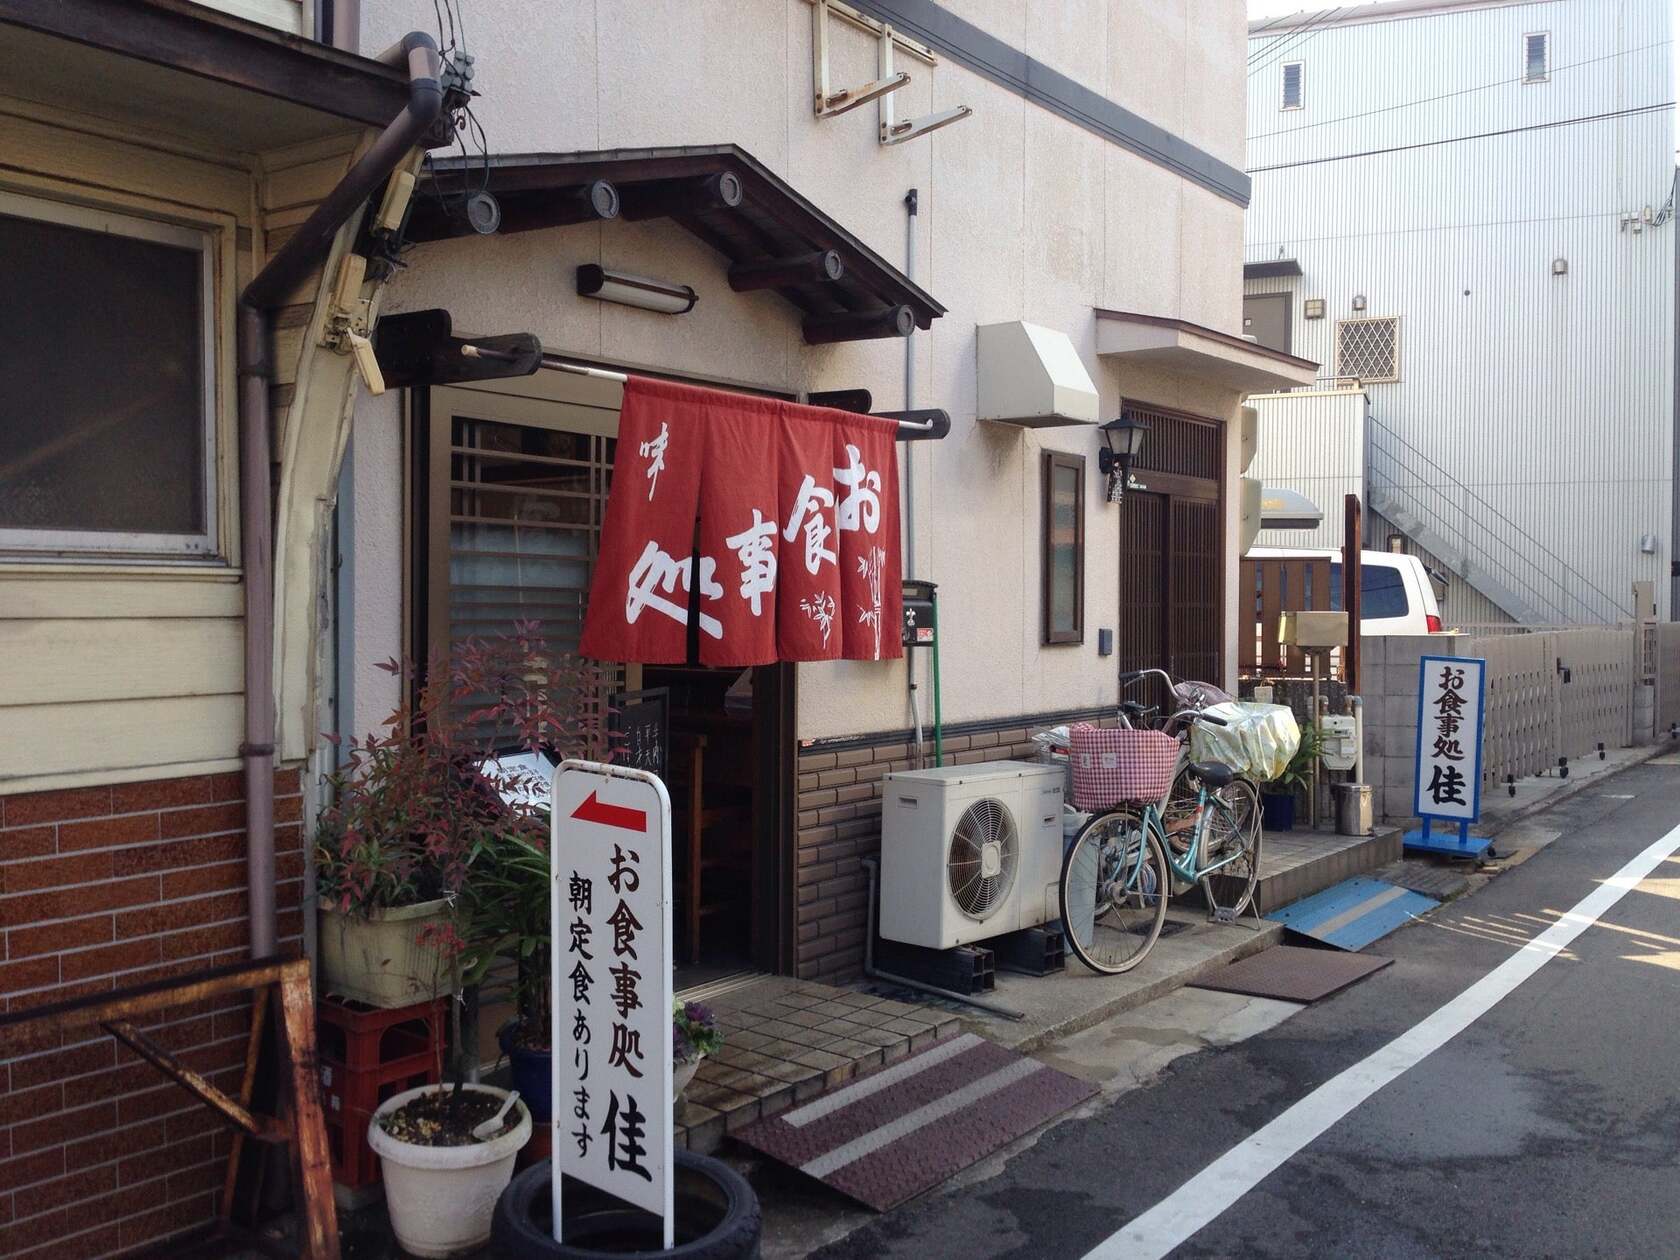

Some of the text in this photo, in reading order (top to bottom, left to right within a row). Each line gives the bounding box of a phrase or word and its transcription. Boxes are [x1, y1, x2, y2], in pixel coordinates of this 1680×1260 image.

[625, 443, 881, 640] お食事処
[1426, 666, 1467, 807] お食事処 佳
[568, 870, 594, 1158] 朝定食あります
[600, 843, 652, 1183] お食事処 佳
